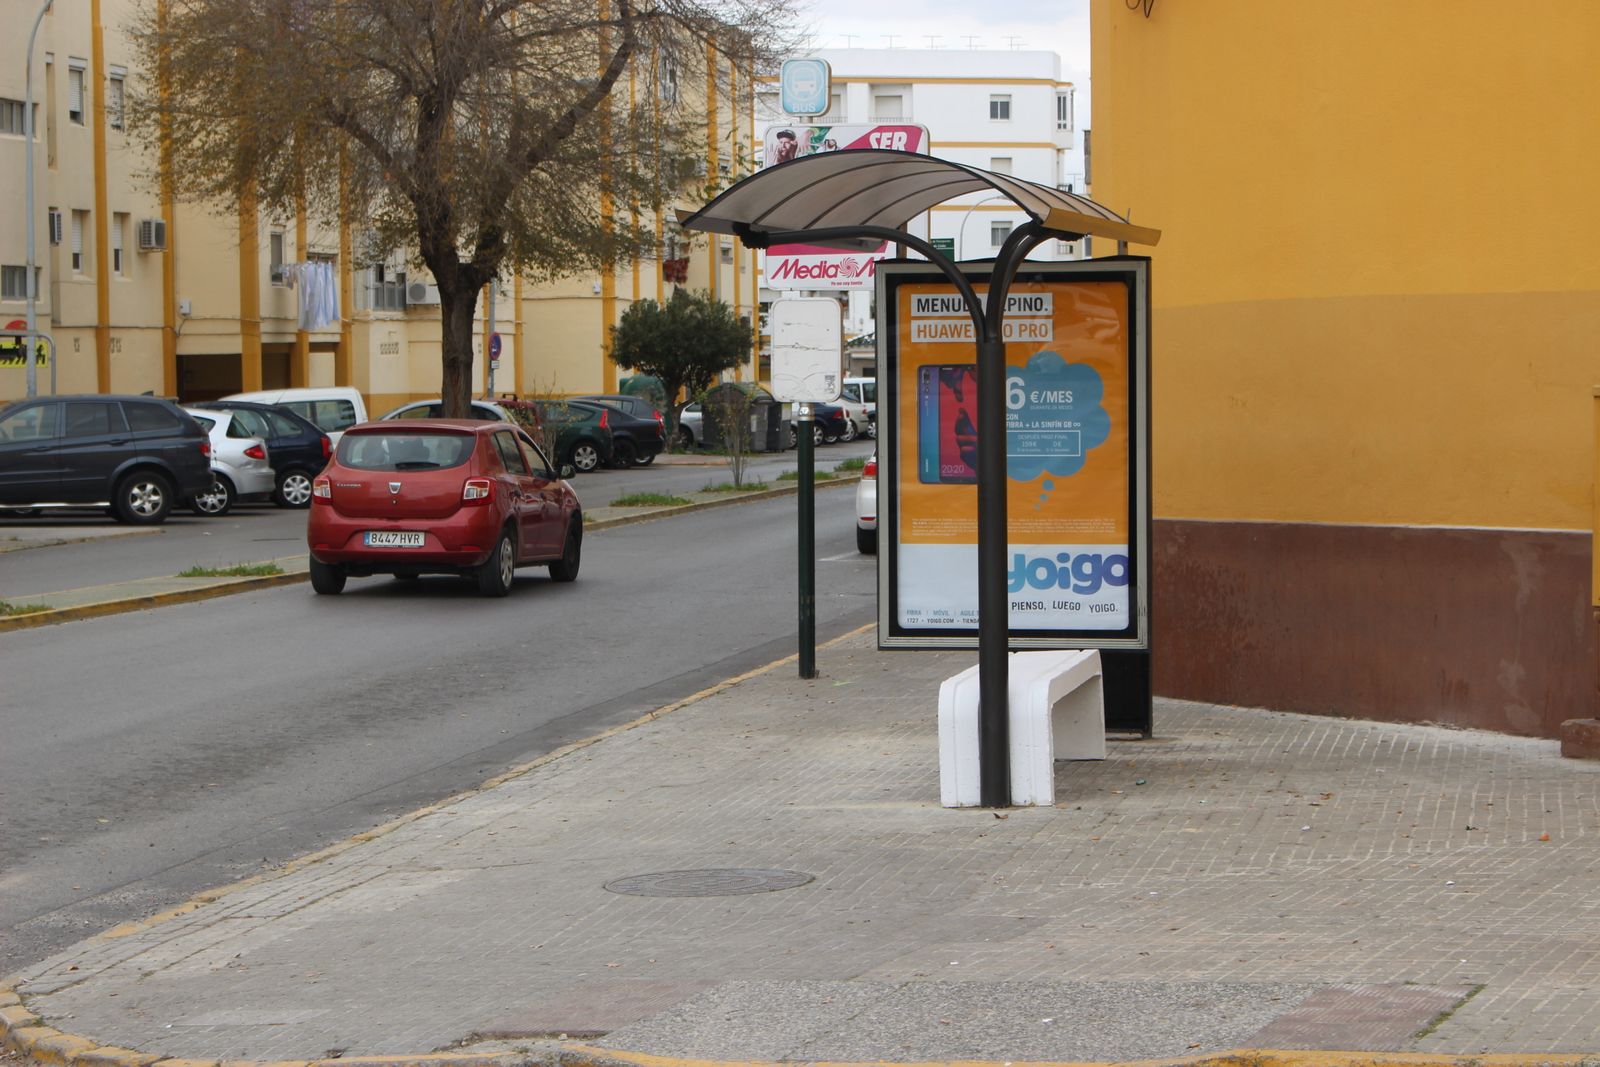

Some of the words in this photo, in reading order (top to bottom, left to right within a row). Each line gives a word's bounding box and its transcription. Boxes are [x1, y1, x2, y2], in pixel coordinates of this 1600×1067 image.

[793, 103, 816, 112] BUS
[869, 131, 908, 149] SER
[771, 258, 841, 280] Media
[1018, 323, 1048, 338] PRO
[1031, 421, 1040, 429] LA
[1063, 421, 1072, 429] GB
[371, 533, 398, 544] 8447
[400, 533, 420, 544] HVR
[1011, 601, 1047, 612] PIENSO,
[1052, 600, 1081, 611] LUEGO
[1089, 603, 1118, 613] YOIGO.
